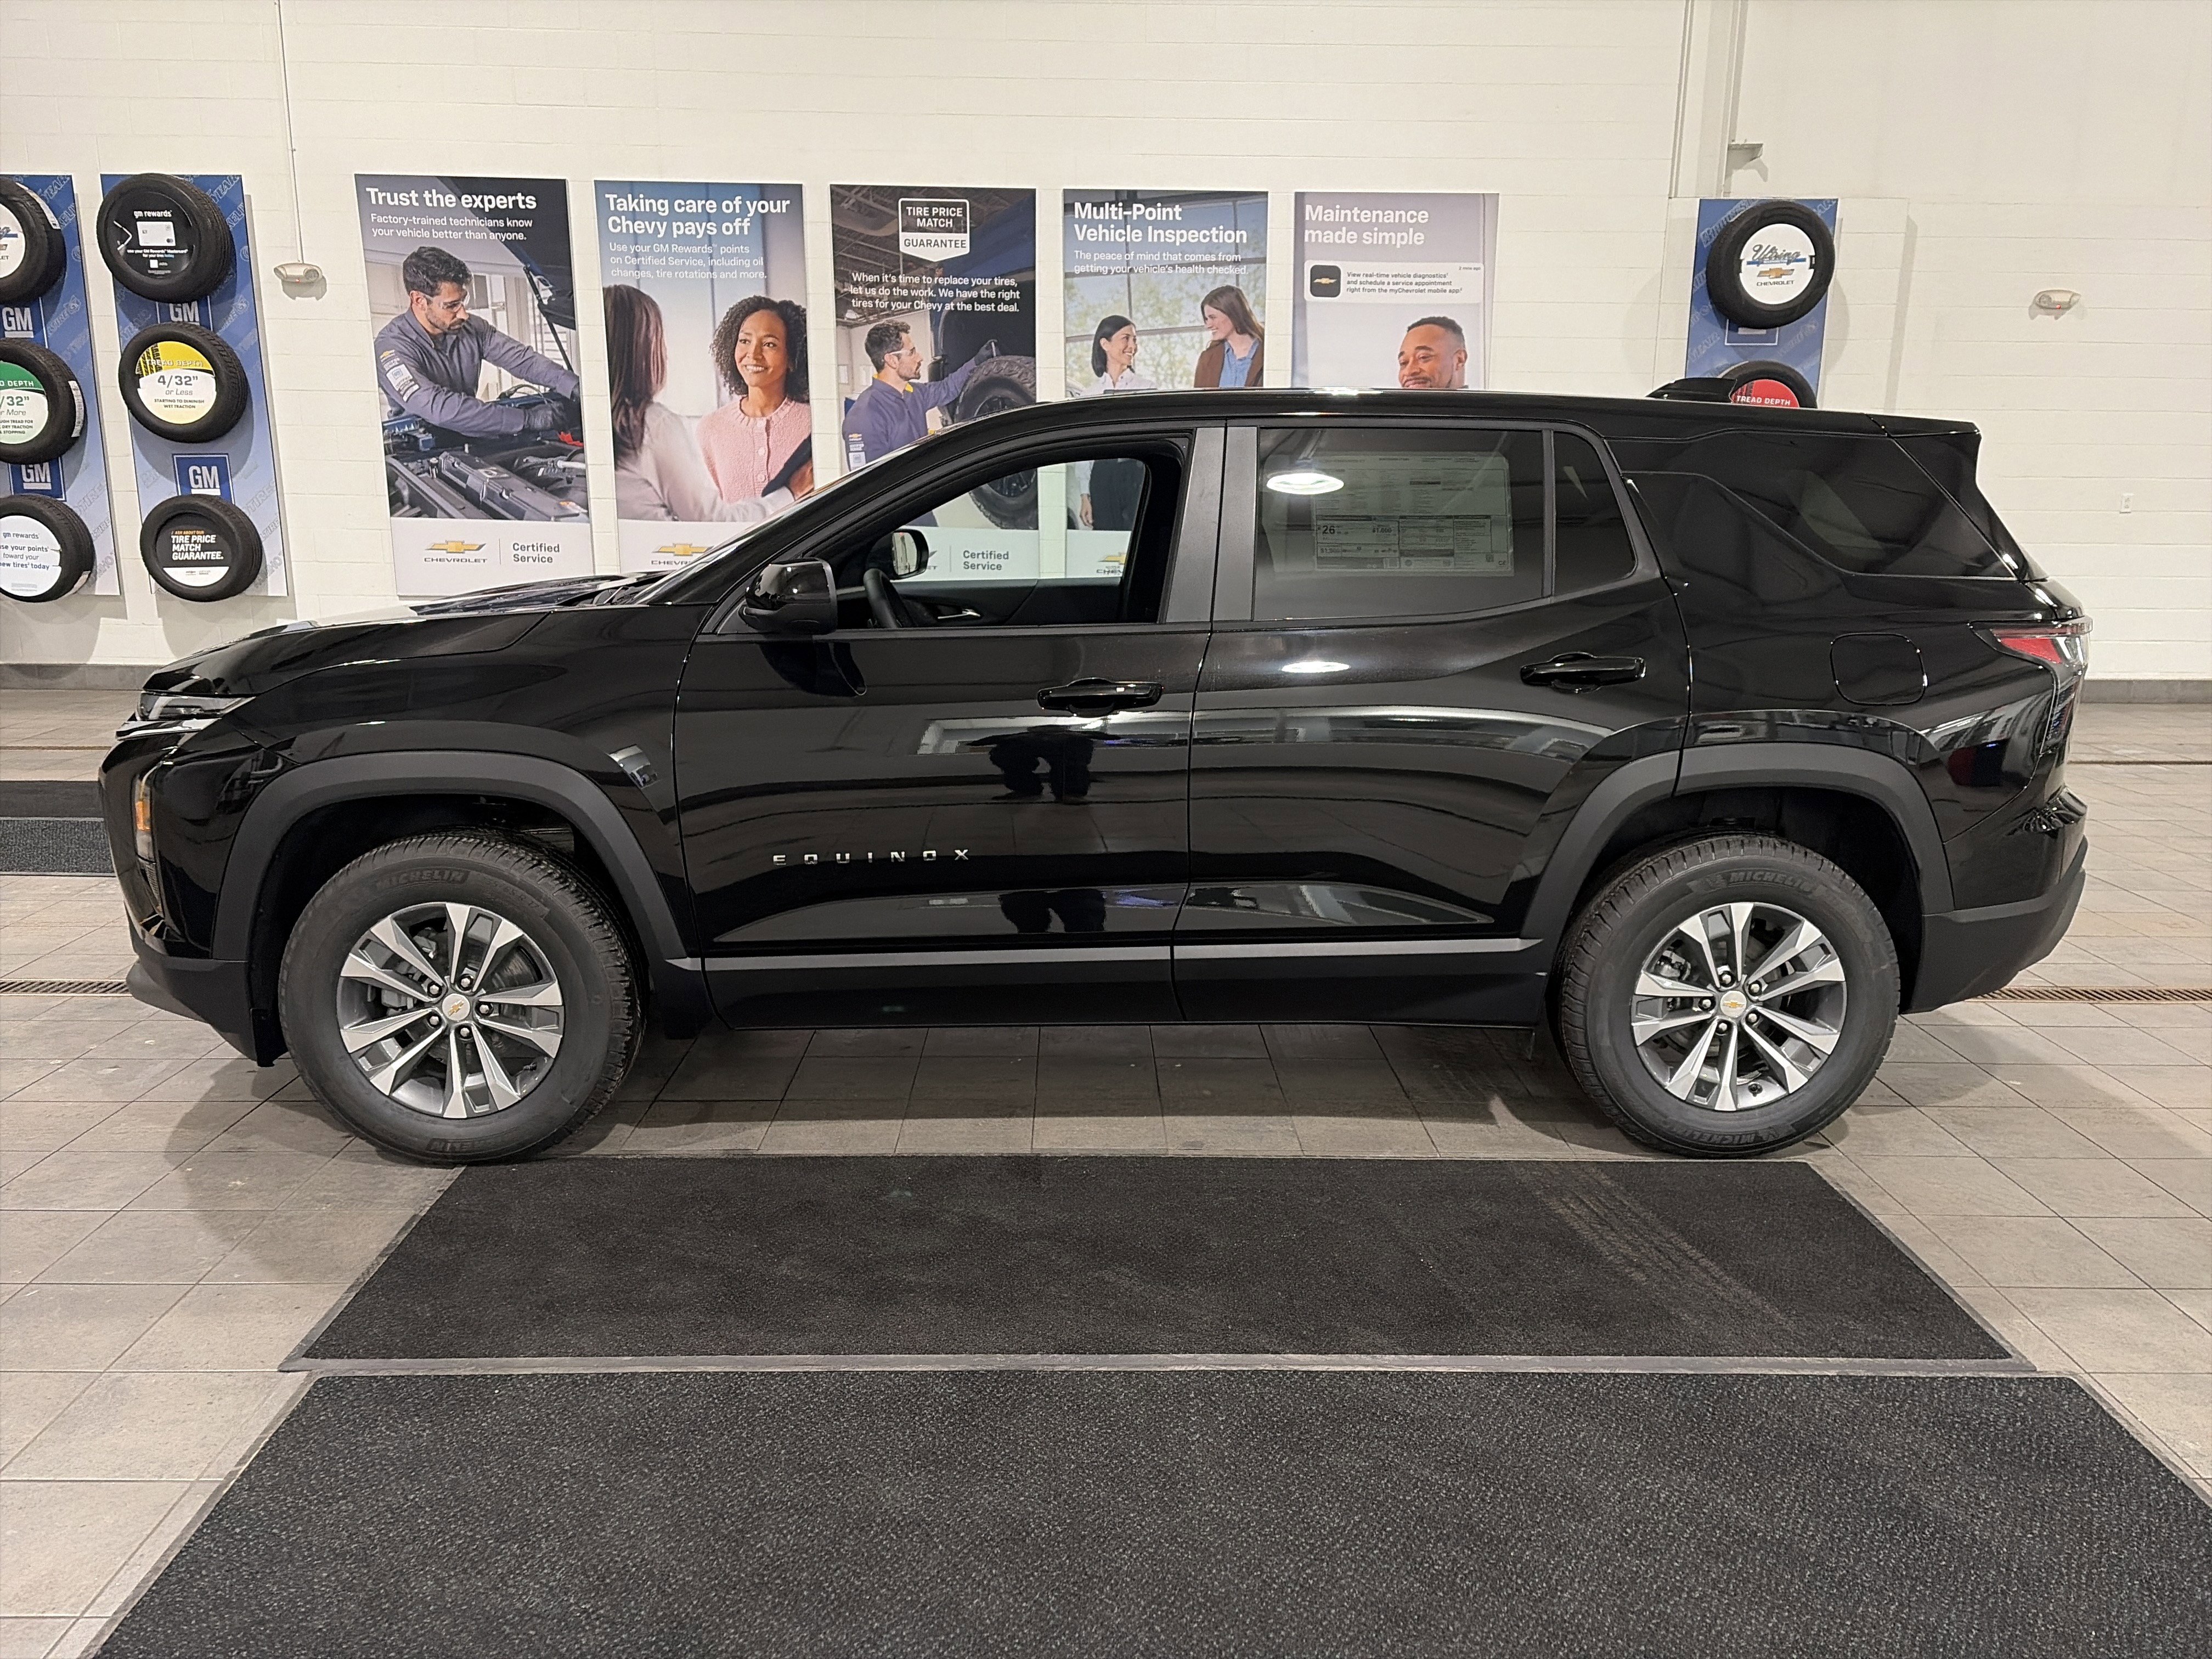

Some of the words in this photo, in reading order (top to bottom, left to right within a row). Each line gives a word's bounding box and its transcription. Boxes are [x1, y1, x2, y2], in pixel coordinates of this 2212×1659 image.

[365, 187, 419, 206] Trust
[423, 189, 456, 207] the
[461, 192, 537, 212] experts
[605, 193, 669, 216] Taking
[674, 199, 716, 213] care
[721, 195, 742, 213] of
[746, 200, 790, 217] your
[906, 206, 929, 216] TIRE
[932, 207, 963, 217] PRICE
[1074, 202, 1182, 221] Multi-Point
[1305, 204, 1429, 223] Maintenance
[370, 213, 447, 226] Factory-trained
[449, 216, 504, 227] technicians
[506, 217, 533, 227] know
[917, 218, 953, 228] MATCH
[371, 228, 394, 237] your
[396, 227, 430, 238] vehicle
[432, 228, 463, 239] better
[464, 229, 487, 240] than
[489, 232, 527, 242] anyone.
[608, 216, 668, 238] Chevy
[672, 221, 717, 239] pays
[721, 217, 751, 235] off
[1074, 224, 1143, 242] Vehicle
[1148, 225, 1247, 246] Inspection
[1304, 226, 1358, 244] made
[1362, 227, 1425, 248] simple
[610, 242, 628, 252] Use
[630, 244, 651, 253] your
[653, 243, 669, 252] GM
[720, 244, 750, 255] points
[904, 238, 966, 249] GUARANTEE
[610, 256, 623, 264] on
[624, 255, 666, 265] Certified
[668, 256, 706, 267] Service,
[708, 256, 751, 268] including
[753, 256, 764, 266] oil
[1074, 250, 1091, 259] The
[1093, 252, 1122, 261] peace
[1125, 251, 1135, 261] of
[1136, 251, 1160, 261] mind
[1162, 251, 1182, 261] that
[1217, 252, 1242, 262] from
[611, 267, 653, 279] changes,
[656, 269, 673, 278] tire
[674, 269, 717, 279] rotations
[719, 269, 737, 279] and
[1074, 264, 1108, 275] getting
[1110, 266, 1132, 274] your
[1133, 264, 1173, 274] vehicle's
[1175, 264, 1205, 274] health
[1206, 264, 1249, 274] checked.
[851, 272, 880, 282] When
[882, 273, 896, 283] it's
[898, 273, 921, 284] time
[922, 275, 933, 284] to
[934, 275, 969, 286] replace
[970, 278, 992, 287] your
[994, 276, 1018, 287] tires,
[850, 285, 863, 295] let
[878, 286, 890, 295] do
[892, 286, 909, 296] the
[910, 287, 936, 297] work.
[938, 288, 954, 297] We
[956, 288, 978, 298] have
[980, 289, 996, 298] the
[997, 289, 1020, 301] right
[851, 298, 873, 308] tires
[874, 298, 889, 308] for
[891, 301, 912, 311] your
[913, 300, 943, 312] Chevy
[944, 301, 955, 311] at
[956, 301, 973, 311] the
[974, 302, 996, 312] best
[997, 302, 1020, 312] deal.
[2, 307, 33, 330] GM
[170, 303, 199, 322] GM
[1736, 396, 1762, 404] TREAD
[1764, 397, 1791, 406] DEPTH
[21, 464, 51, 484] GM
[188, 466, 220, 489] GM
[1322, 525, 1335, 534] 26
[171, 534, 190, 544] TIRE
[191, 534, 217, 543] PRICE
[172, 543, 201, 552] MATCH
[512, 542, 560, 552] Certified
[172, 551, 224, 560] GUARANTEE.
[513, 554, 553, 563] Service
[963, 550, 1009, 560] Certified
[963, 561, 1002, 571] Service
[772, 848, 969, 866] EQUINOX
[376, 869, 465, 890] MICHELIN
[1729, 871, 1812, 892] MICHELIN
